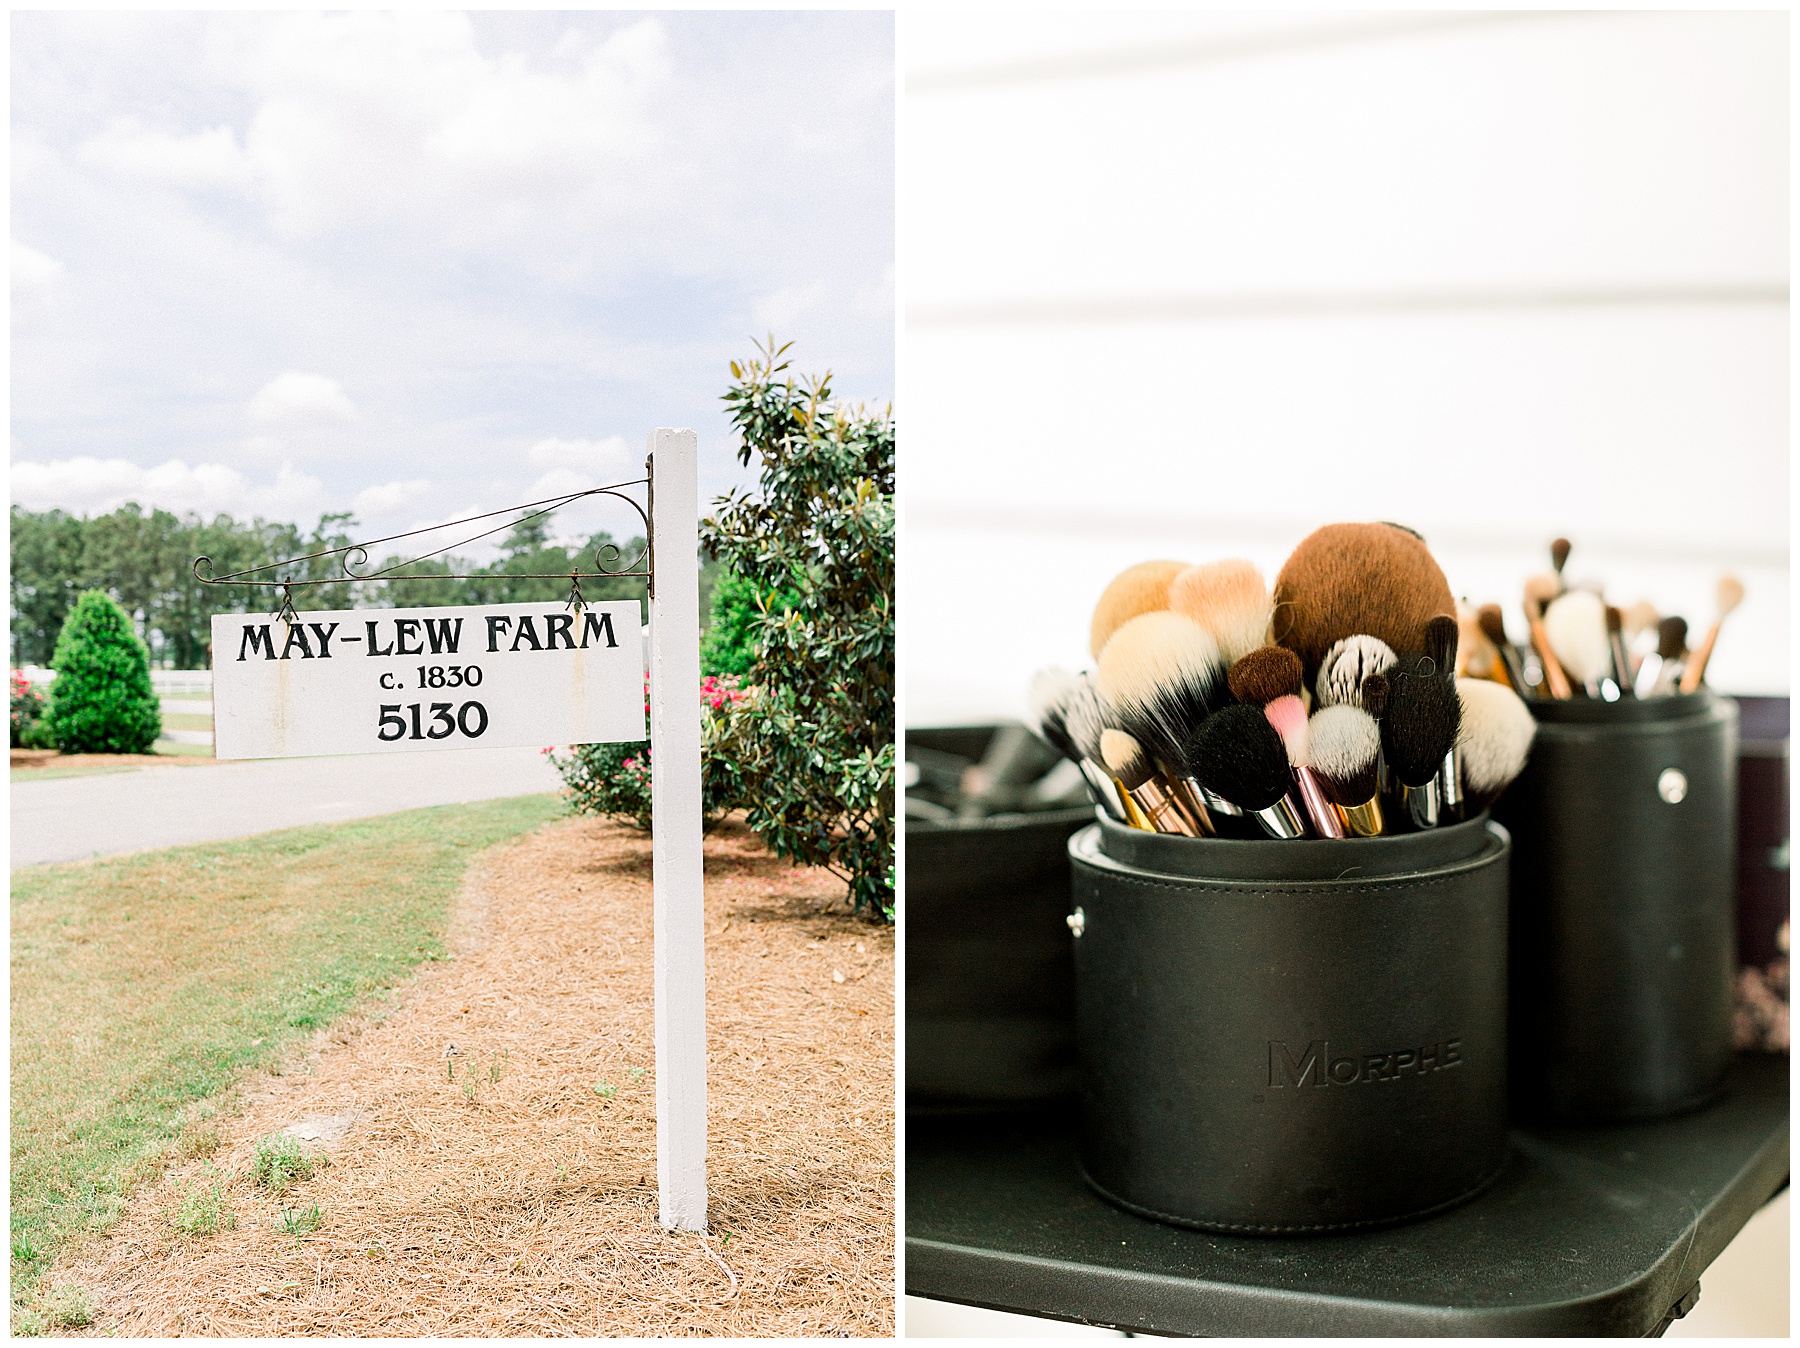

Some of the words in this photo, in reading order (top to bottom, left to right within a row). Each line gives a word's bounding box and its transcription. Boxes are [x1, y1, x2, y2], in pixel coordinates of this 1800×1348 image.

[236, 617, 464, 661] MAY-LEW
[485, 612, 619, 653] FARM
[379, 673, 404, 690] c.
[417, 665, 483, 689] 1830
[377, 700, 489, 742] 5130
[1267, 1038, 1464, 1088] MORPHE
